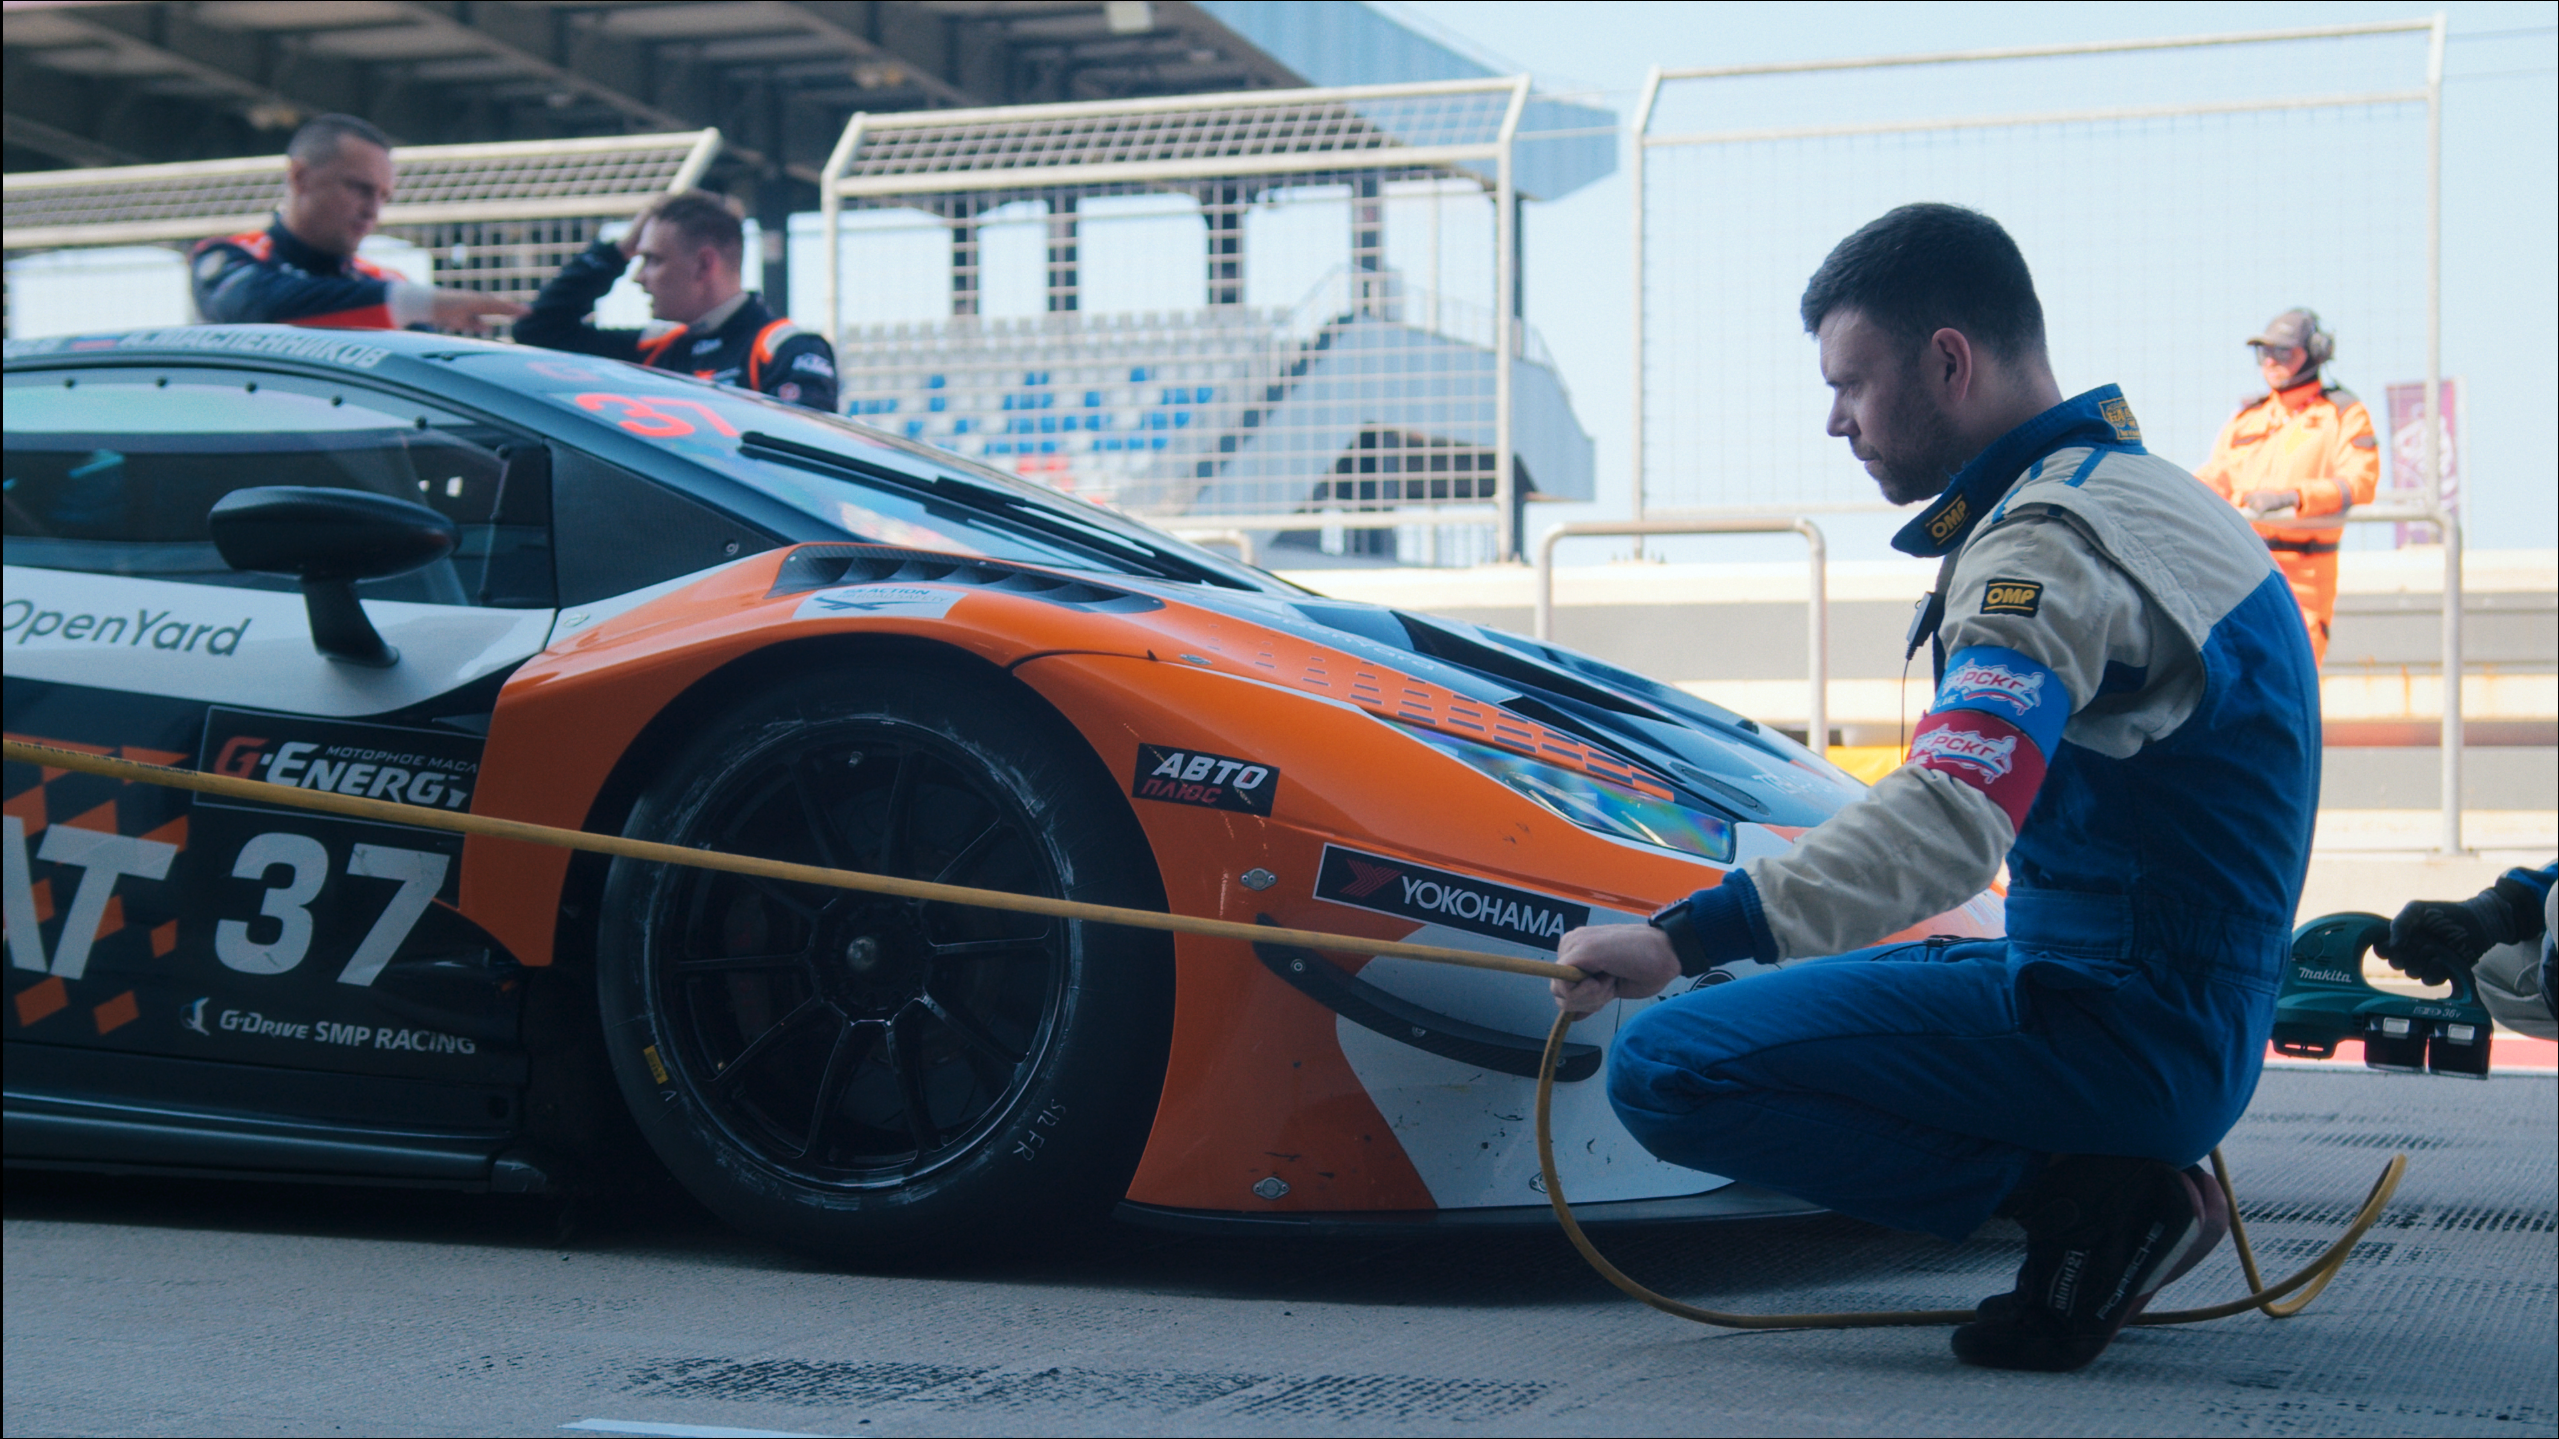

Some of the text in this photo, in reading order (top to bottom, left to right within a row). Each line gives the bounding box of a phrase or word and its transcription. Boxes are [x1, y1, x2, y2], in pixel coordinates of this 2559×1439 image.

[574, 392, 741, 438] 37
[1931, 500, 1967, 538] OMP
[1986, 588, 2036, 604] OMP
[3, 599, 252, 657] OpenYard
[1140, 778, 1222, 803] ПЛЮС
[1151, 752, 1269, 790] АВТО
[214, 832, 451, 988] 37
[1402, 875, 1565, 938] YOKOHAMA
[314, 1020, 372, 1047] SMP
[374, 1028, 477, 1055] RACING
[2096, 1221, 2166, 1320] PORSCHE
